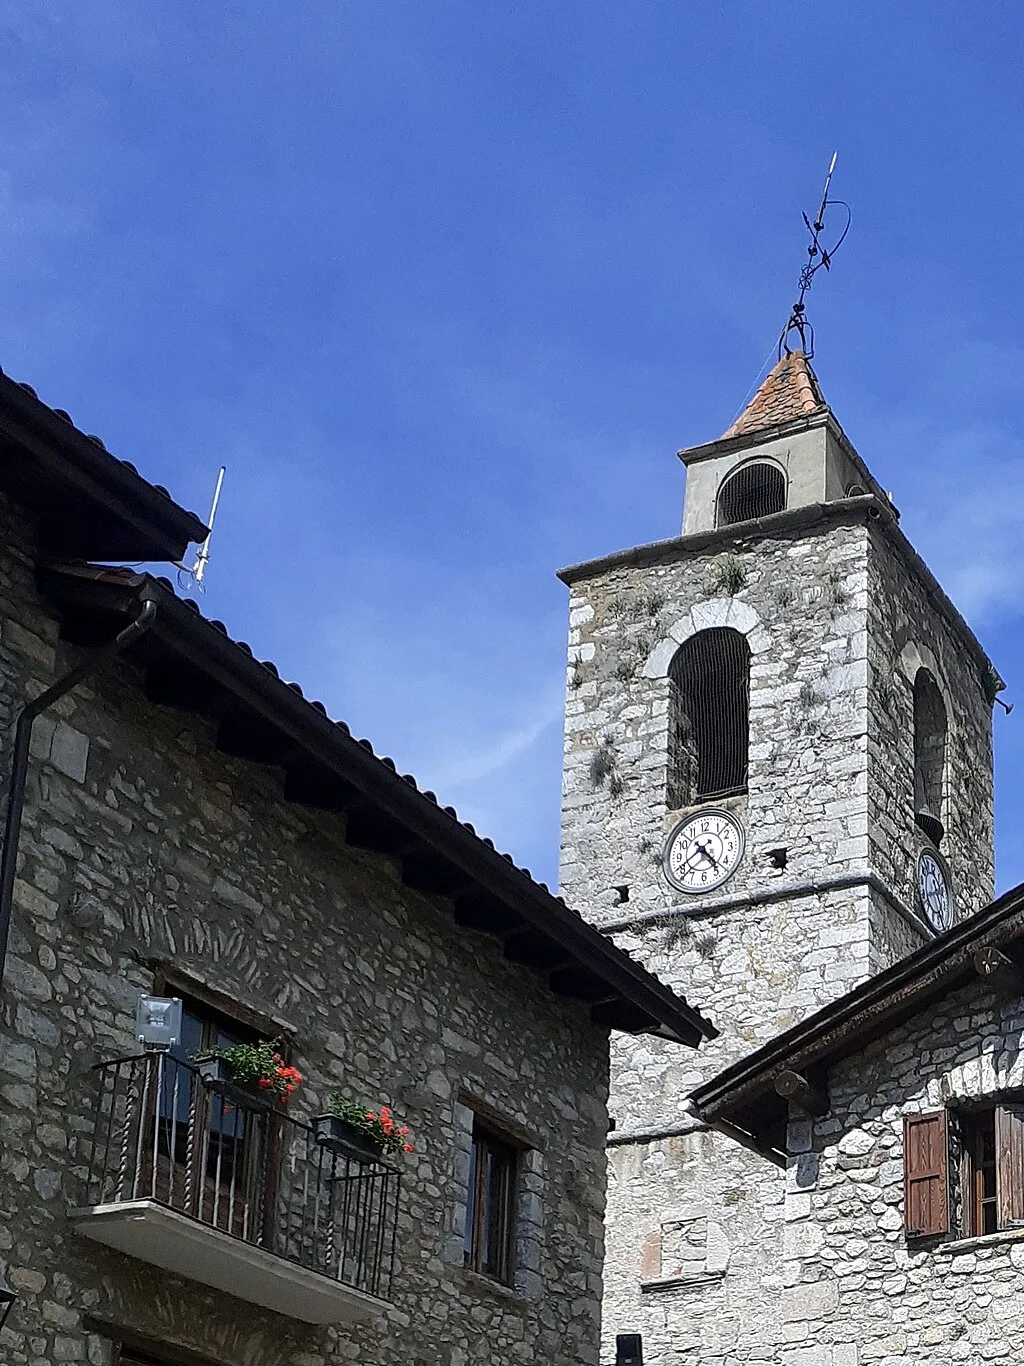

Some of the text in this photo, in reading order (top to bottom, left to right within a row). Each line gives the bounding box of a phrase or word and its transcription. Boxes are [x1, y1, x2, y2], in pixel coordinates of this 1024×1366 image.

[690, 827, 696, 837] 11
[701, 821, 710, 832] 12
[716, 822, 719, 832] 1
[724, 829, 730, 840] 2
[677, 840, 688, 850] 10
[727, 841, 733, 852] 3
[676, 852, 682, 863] 9
[722, 855, 729, 865] 4
[713, 865, 719, 876] 5
[690, 871, 695, 882] 7
[701, 871, 707, 882] 6
